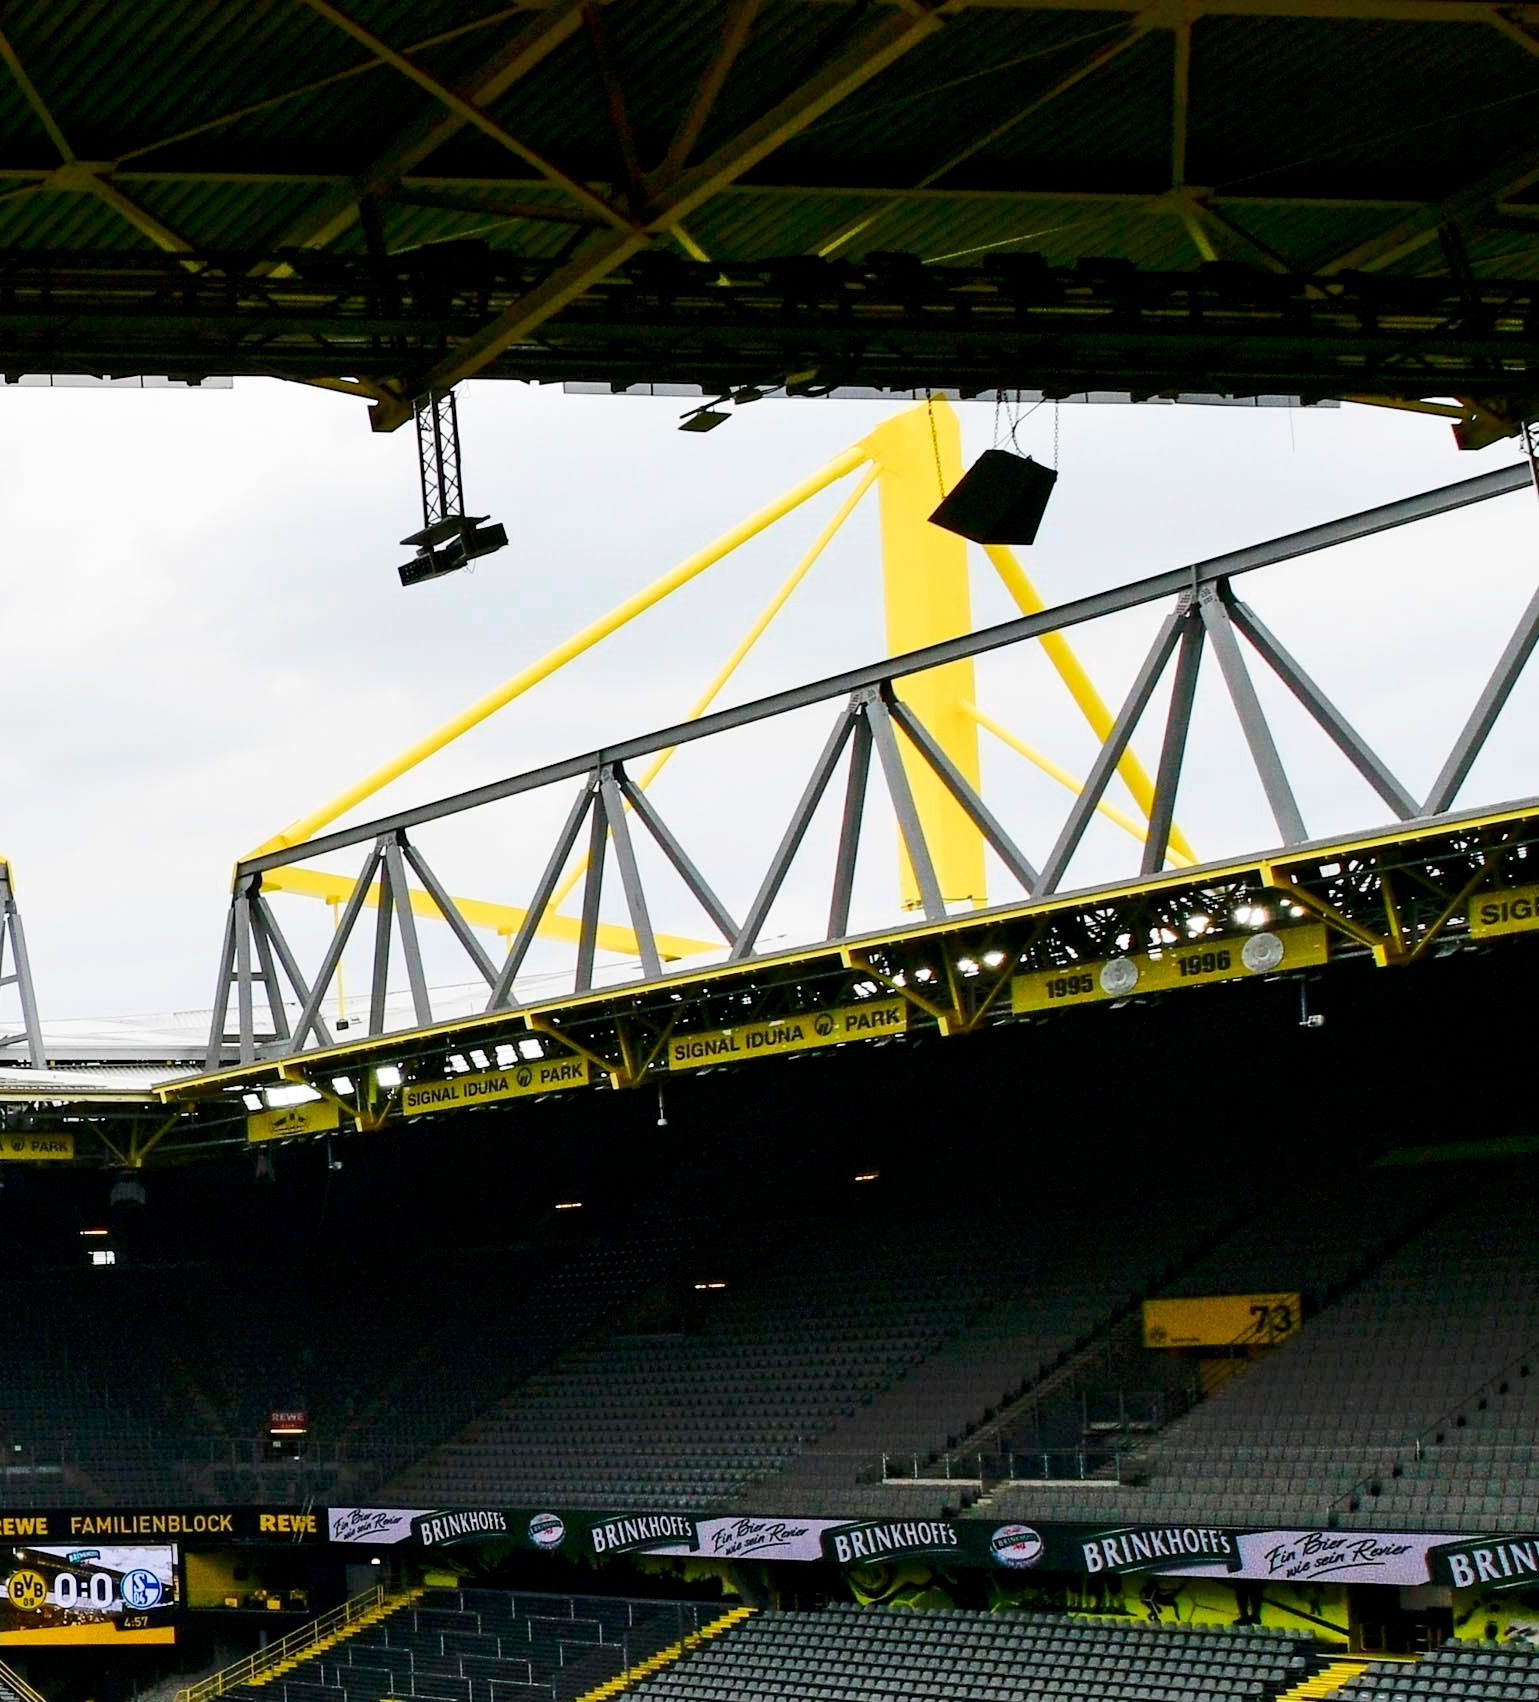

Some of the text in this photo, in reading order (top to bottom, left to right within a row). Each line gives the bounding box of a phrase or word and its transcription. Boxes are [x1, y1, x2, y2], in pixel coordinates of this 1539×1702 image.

[1045, 949, 1232, 999] 1995 1996
[674, 1004, 901, 1061] SIGNAL IDUNA PARK
[407, 1063, 583, 1108] SIGNAL IDUNA PARK
[71, 1514, 233, 1535] FAMILIENBLOCK
[260, 1514, 317, 1533] REWE
[54, 1573, 113, 1609] 0:0
[124, 1616, 148, 1628] 4:57
